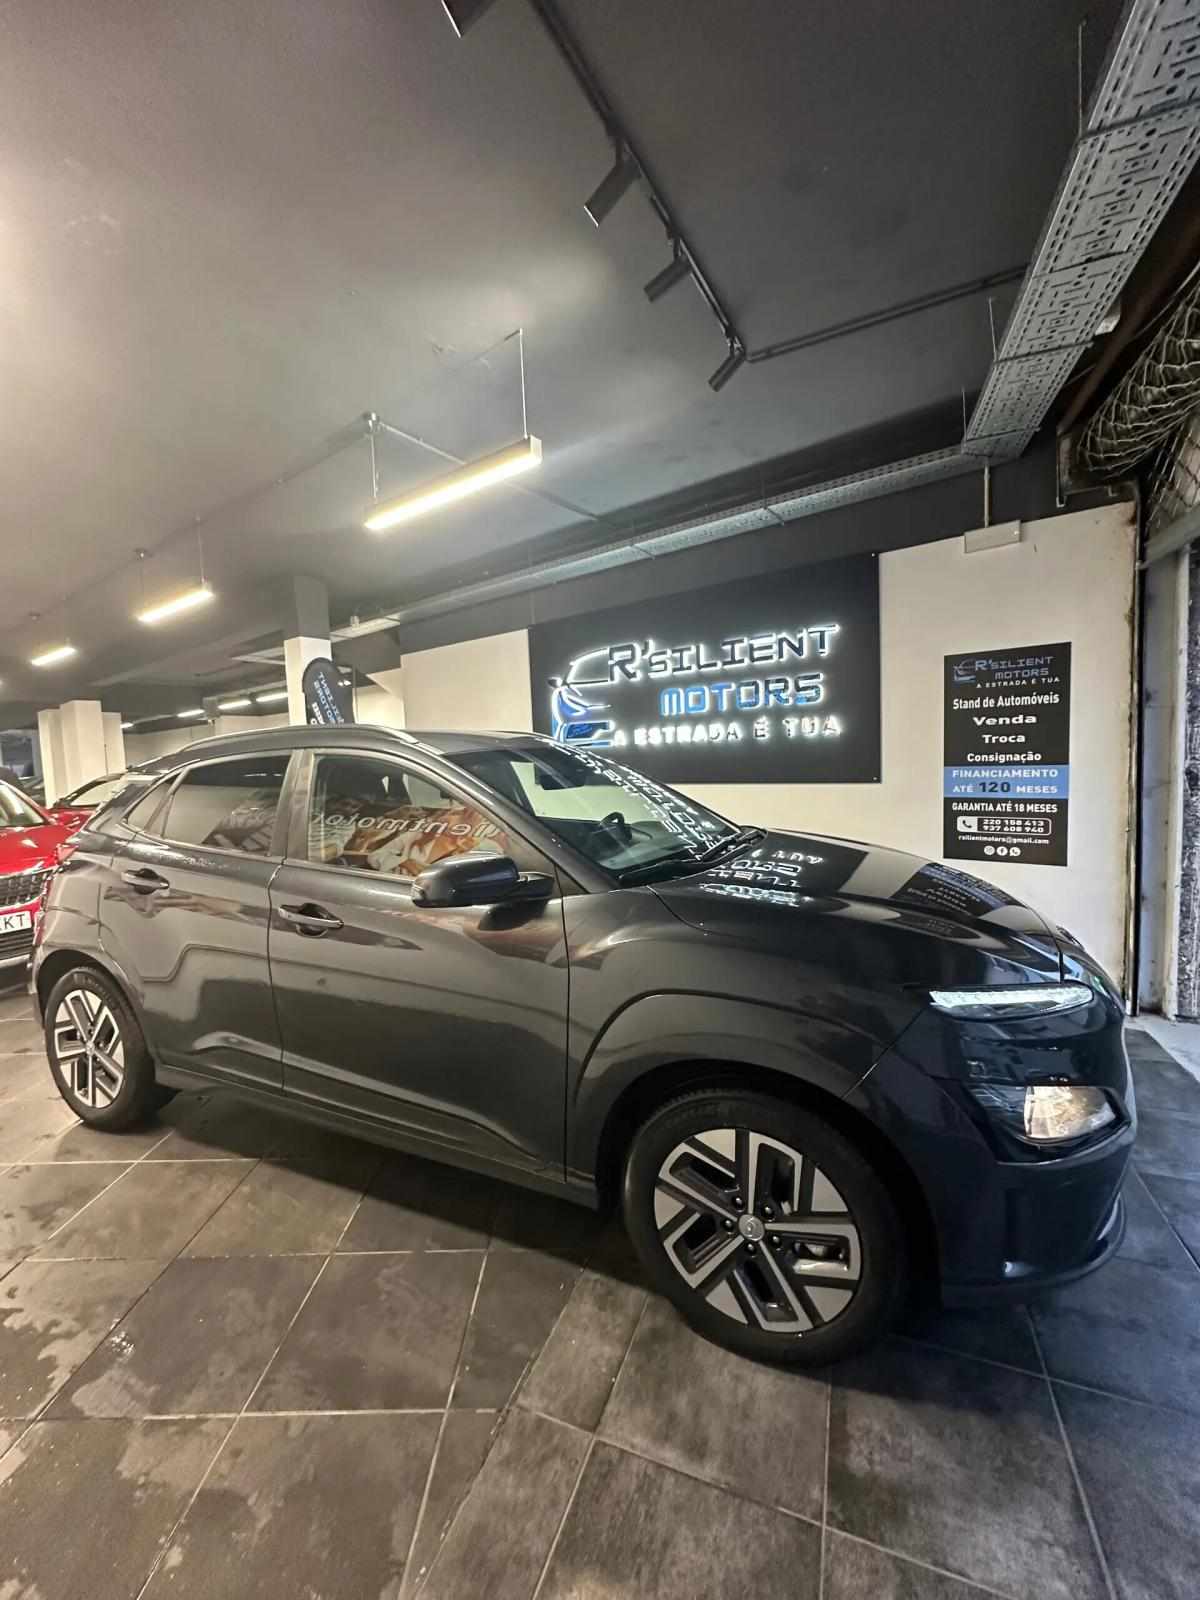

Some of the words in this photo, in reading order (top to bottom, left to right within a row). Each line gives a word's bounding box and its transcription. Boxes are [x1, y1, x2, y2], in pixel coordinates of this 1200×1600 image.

[995, 667, 1049, 680] MOTORS
[986, 679, 1027, 688] ESTRADA
[660, 672, 824, 717] MOTORS
[953, 697, 980, 710] Stand
[982, 697, 995, 708] de
[997, 691, 1060, 708] Automóveis
[972, 714, 1037, 726] Venda
[612, 730, 627, 747] A
[634, 721, 743, 745] ESTRADA
[783, 715, 842, 739] TUA
[982, 734, 1026, 744] Troca
[967, 752, 1042, 763] Consignação
[952, 769, 1059, 778] FINANCIAMENTO
[953, 783, 973, 792] ATÉ
[978, 782, 1010, 793] 120
[1016, 785, 1057, 793] MESES
[952, 802, 993, 811] GARANTIA
[994, 801, 1012, 812] ATÉ
[1015, 804, 1025, 812] 18
[1027, 803, 1058, 813] MESES
